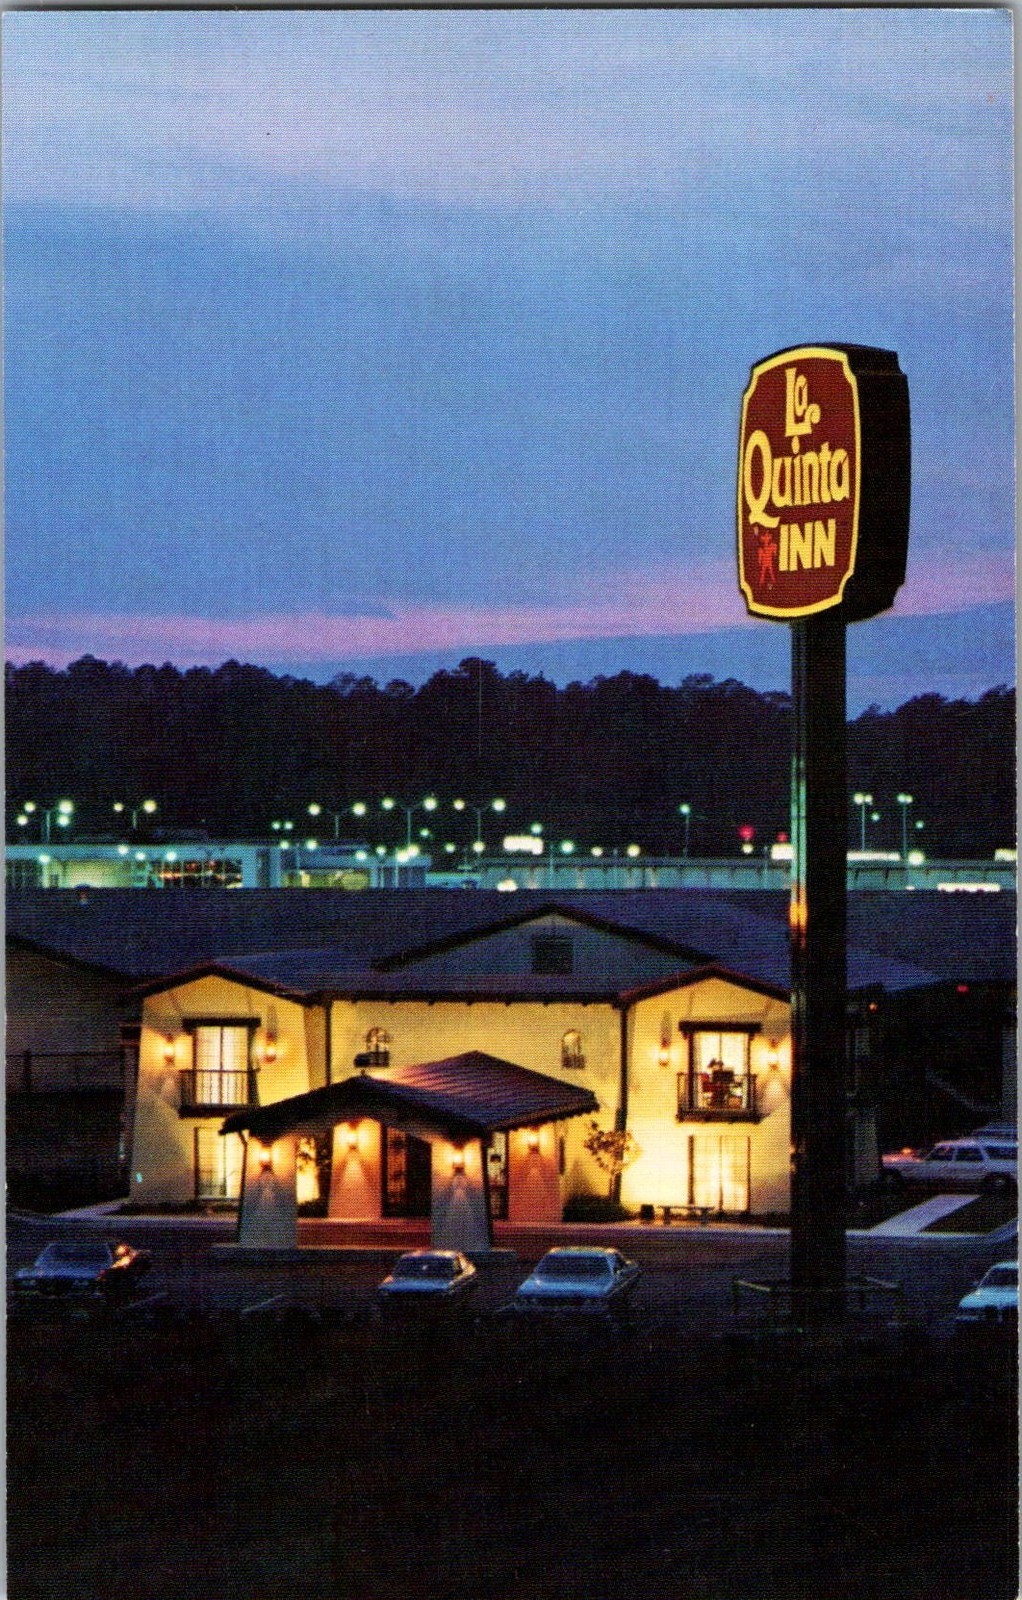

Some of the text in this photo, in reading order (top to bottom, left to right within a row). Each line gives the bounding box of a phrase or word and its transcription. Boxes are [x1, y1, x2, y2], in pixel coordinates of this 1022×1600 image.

[785, 367, 821, 437] La
[744, 430, 850, 528] Quinta
[778, 518, 836, 571] INN
